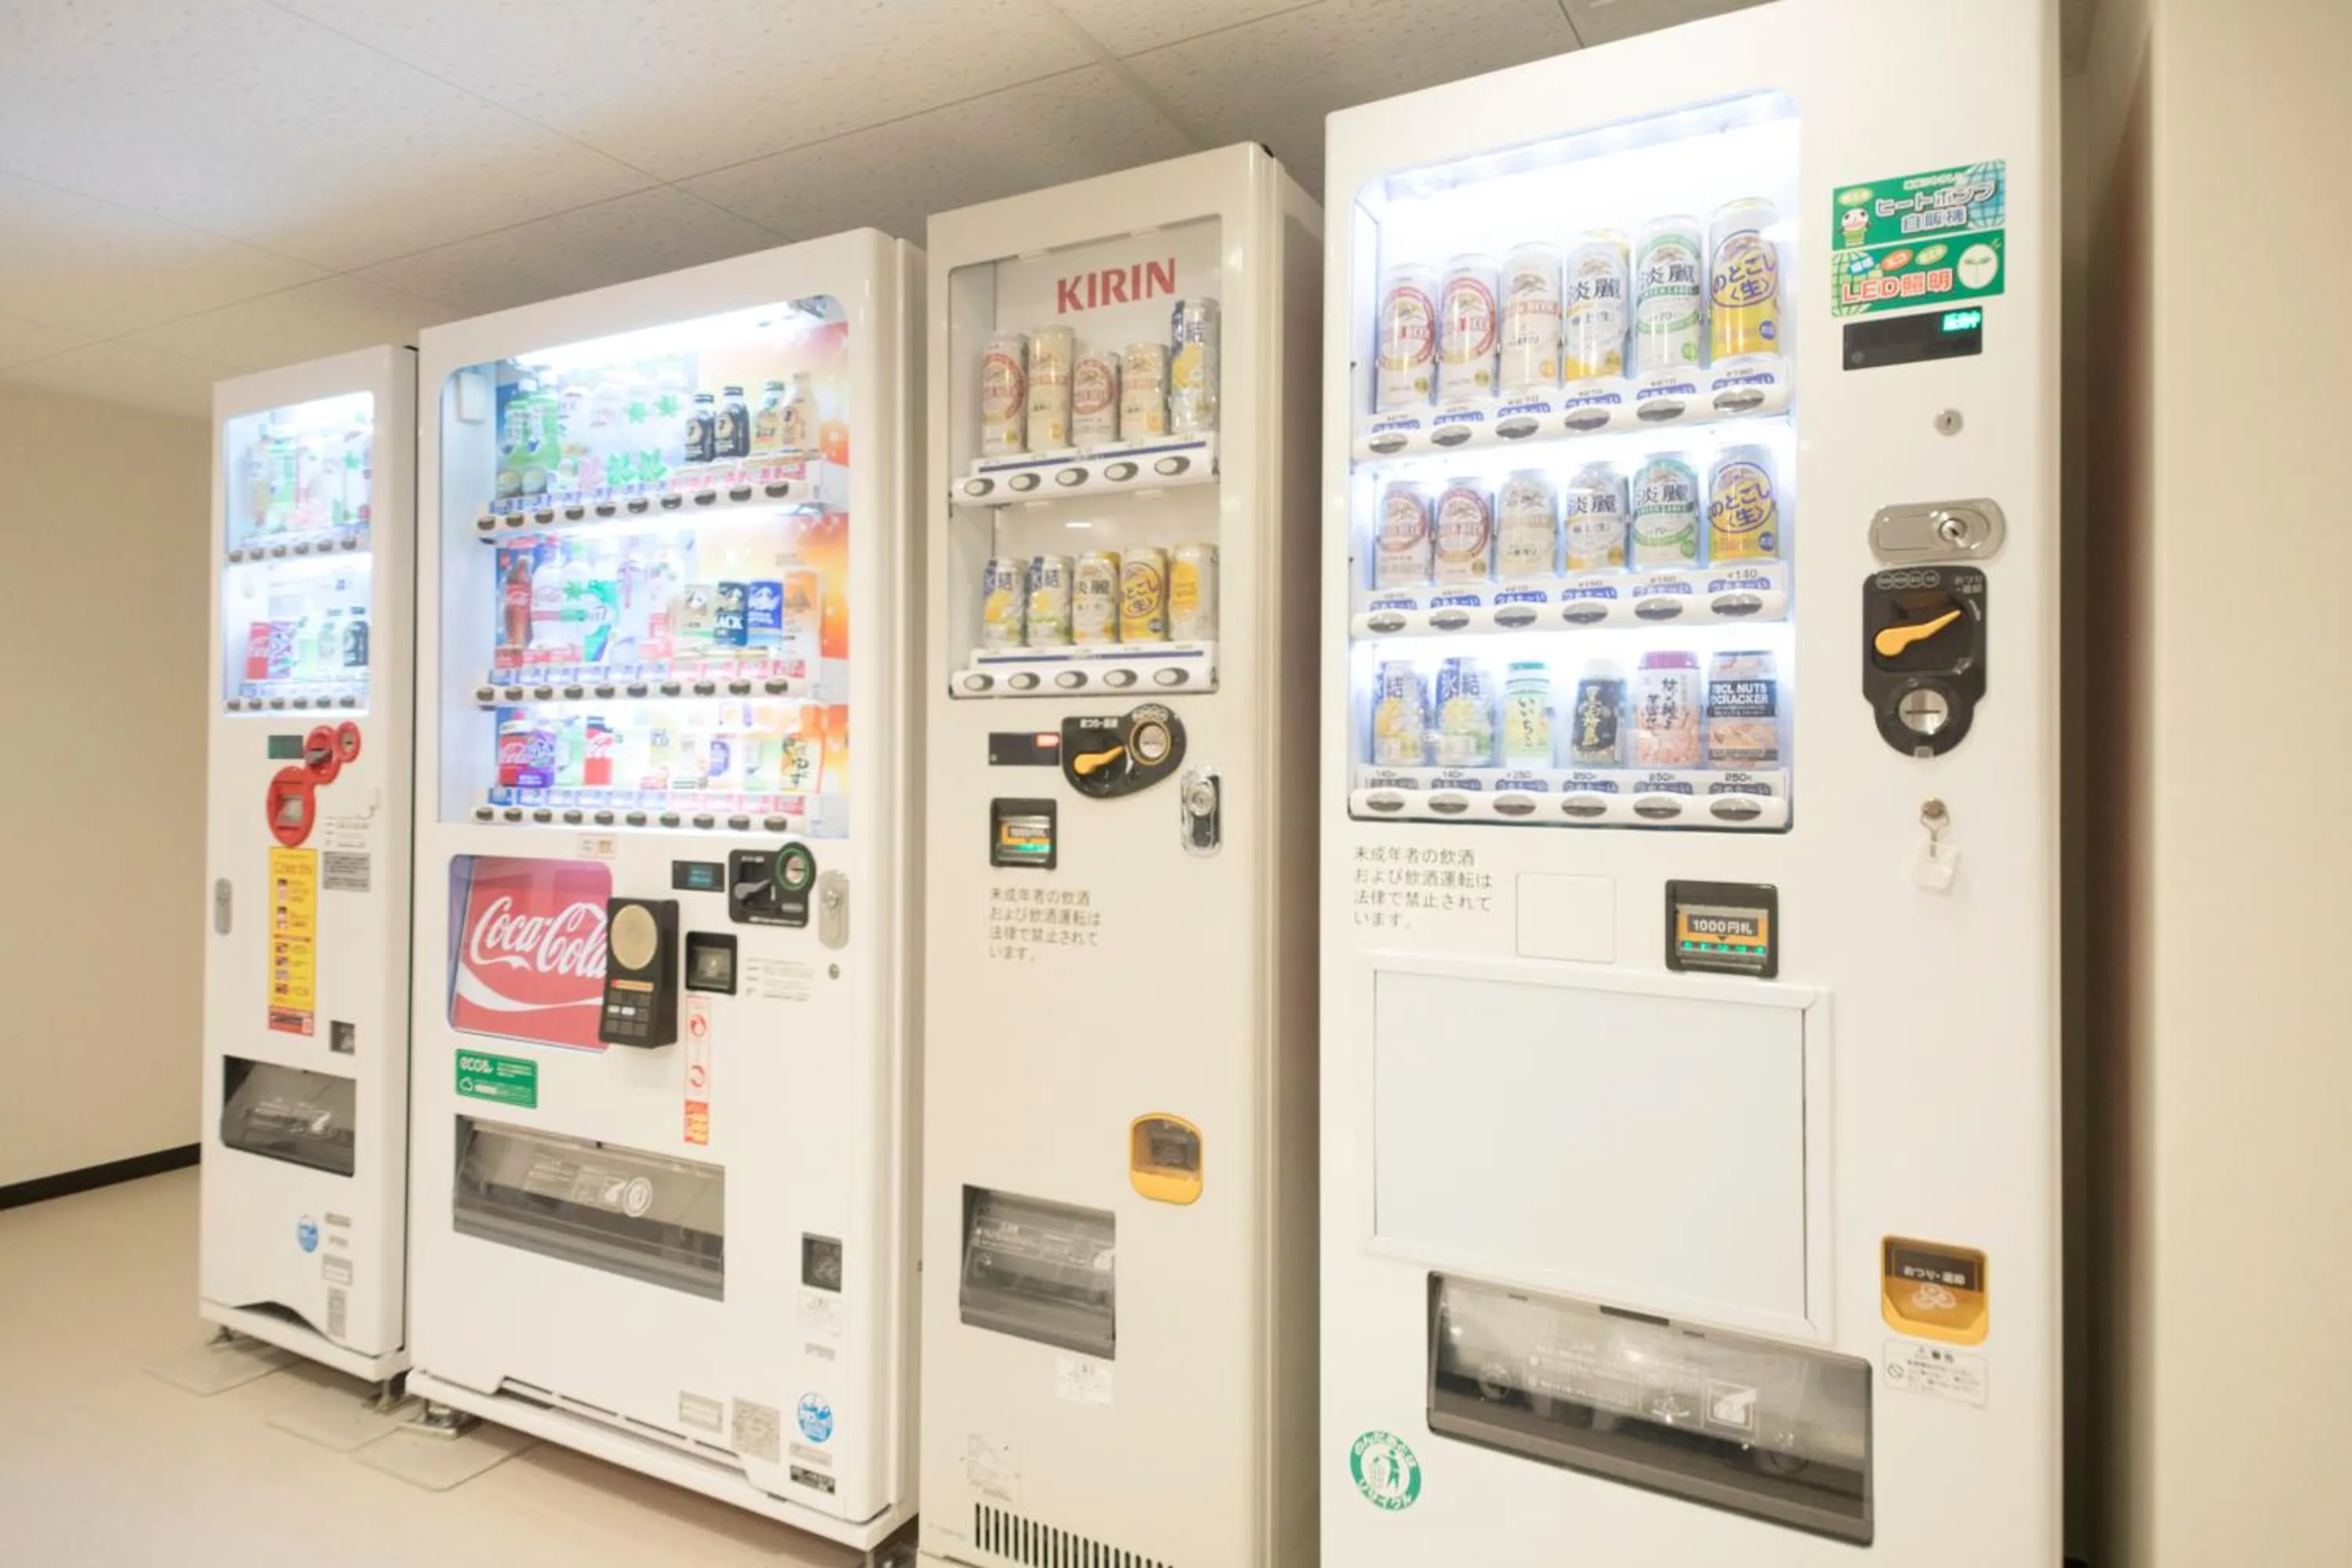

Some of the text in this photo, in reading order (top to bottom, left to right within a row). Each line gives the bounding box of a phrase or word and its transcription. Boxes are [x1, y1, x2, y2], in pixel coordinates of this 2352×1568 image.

[1057, 257, 1176, 314] KIRIN
[1842, 268, 1953, 303] LED照明
[1737, 683, 1768, 693] NUTS
[1354, 845, 1475, 867] 未成年者の飲酒
[1354, 868, 1493, 890] および飲酒運転は
[1354, 889, 1492, 912] 法律で禁止されて
[1354, 912, 1413, 930] います。
[1692, 917, 1753, 936] 1000円札
[472, 896, 608, 979] Coca-Cola
